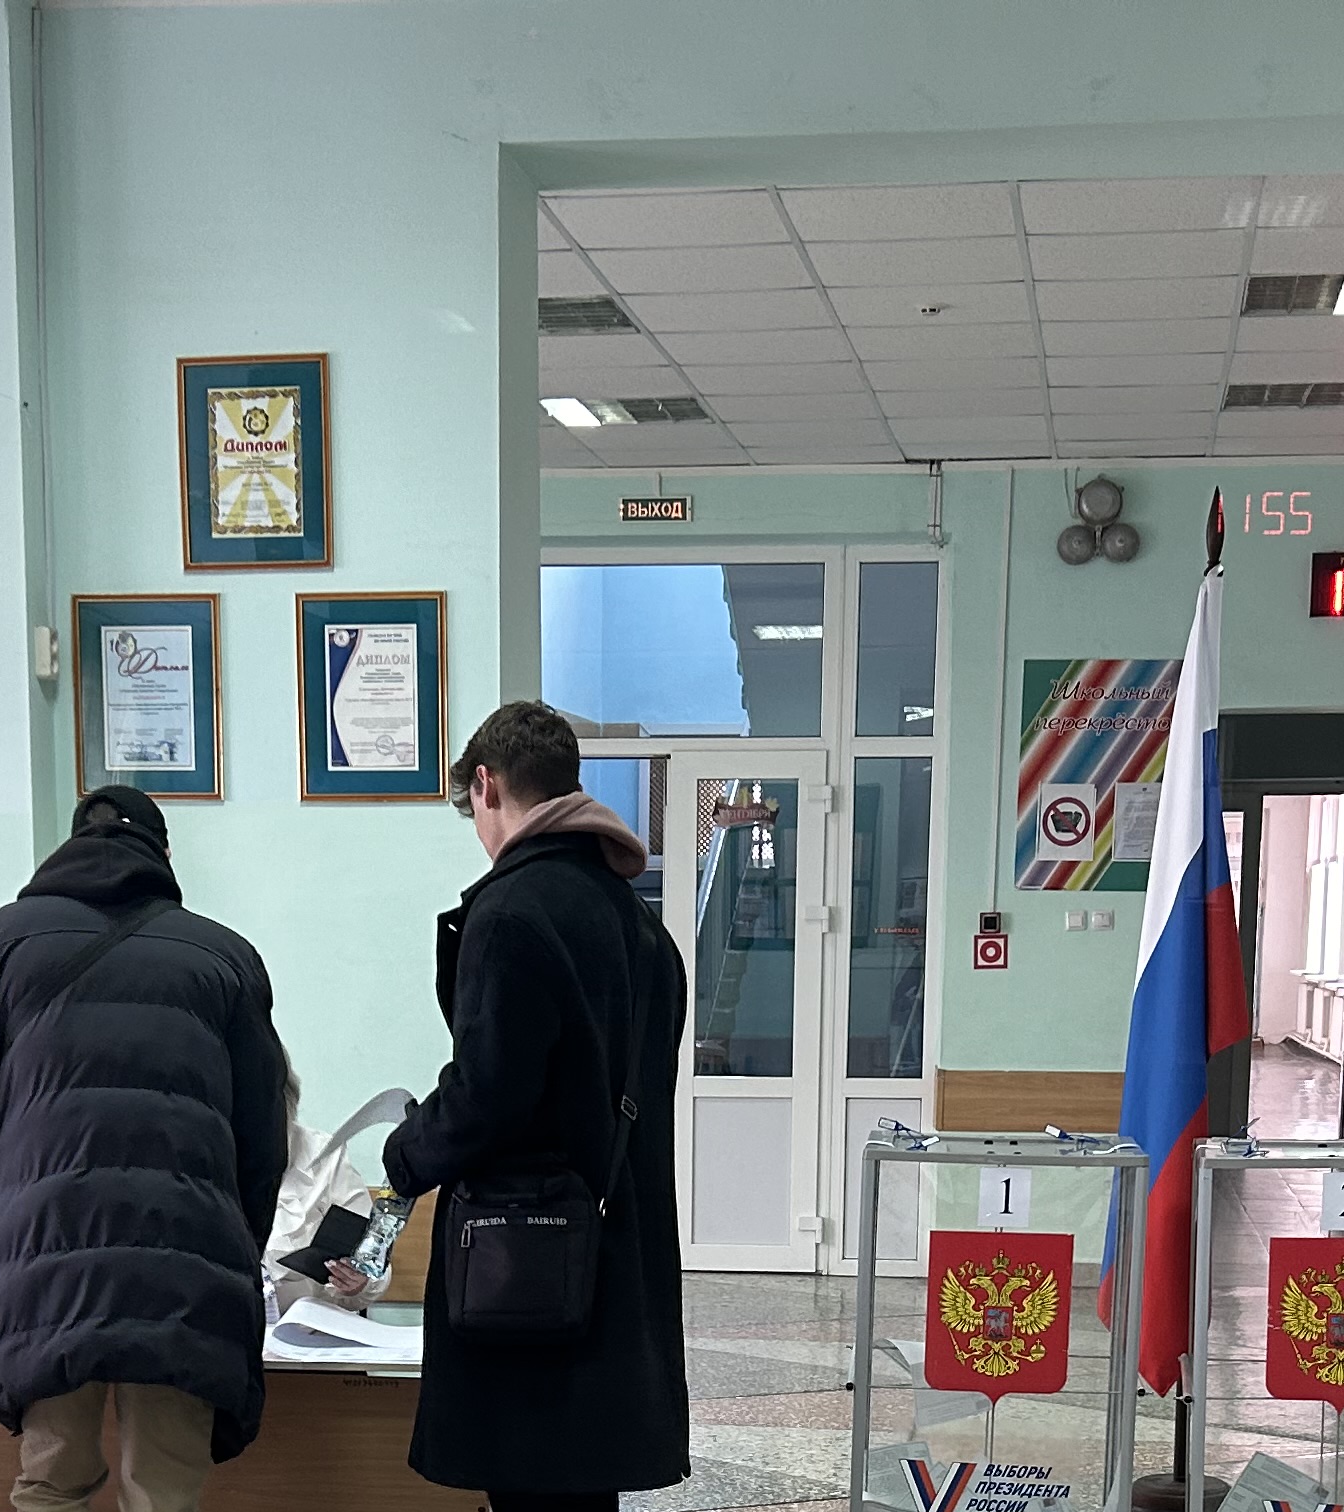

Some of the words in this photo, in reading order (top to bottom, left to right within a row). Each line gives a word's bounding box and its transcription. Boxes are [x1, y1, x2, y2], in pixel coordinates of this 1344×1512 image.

[223, 438, 288, 453] Диплом
[627, 502, 683, 519] ВЫХОД
[356, 654, 411, 667] ДИПЛОМ
[1049, 680, 1171, 700] Школьный
[1034, 712, 1172, 736] перекрёсто
[1000, 1177, 1015, 1215] 1
[983, 1463, 1053, 1480] ВЫБОРЫ
[974, 1481, 1071, 1499] ПРЕЗИДЕНТА
